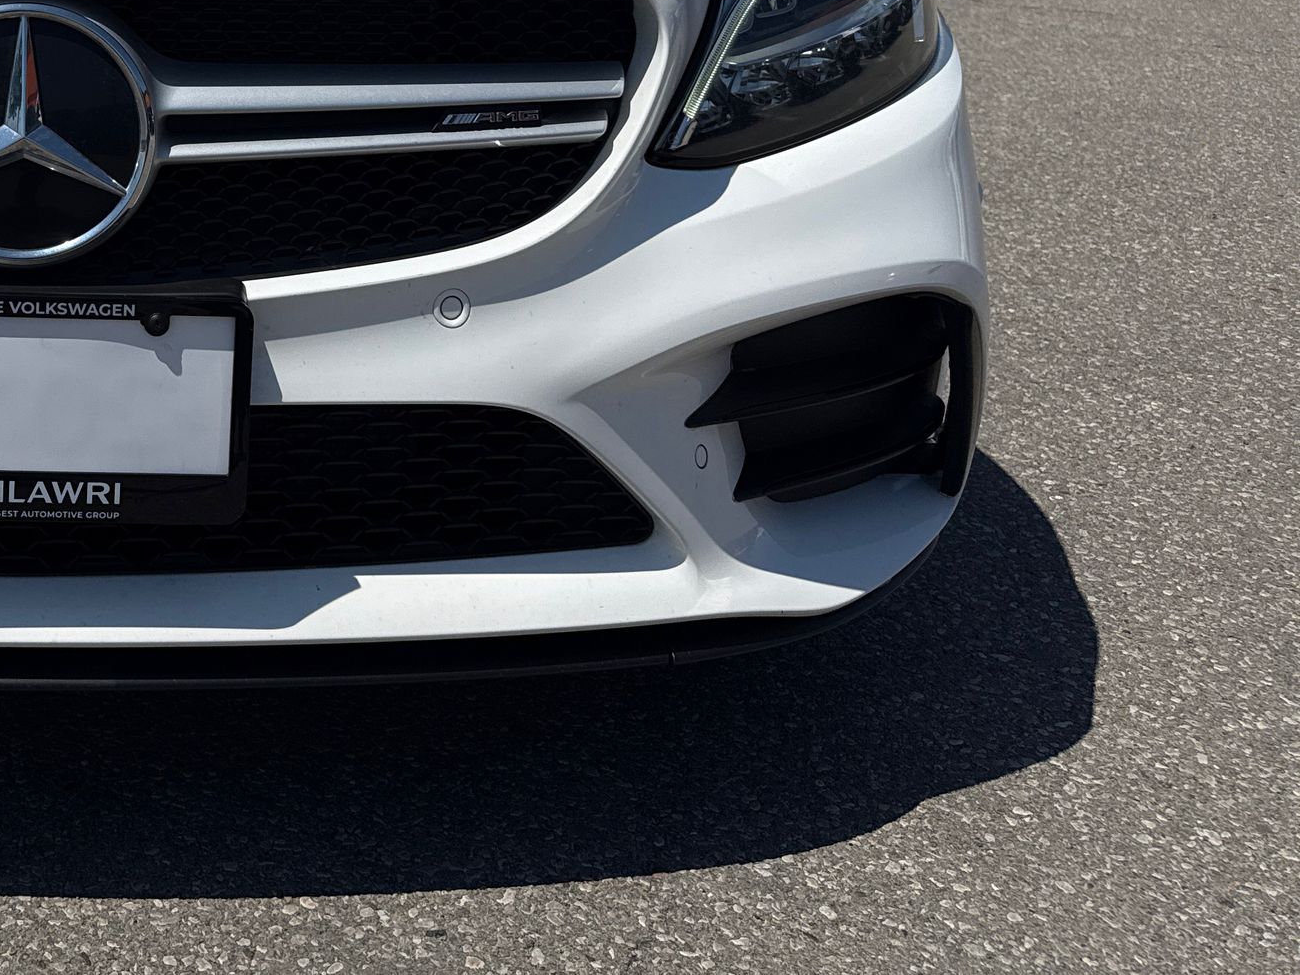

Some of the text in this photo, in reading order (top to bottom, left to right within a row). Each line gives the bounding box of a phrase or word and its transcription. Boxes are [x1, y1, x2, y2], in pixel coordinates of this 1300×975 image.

[474, 110, 539, 123] AMG
[8, 301, 136, 317] VOLKSWAGEN
[20, 510, 83, 519] AUTOMOTIVE
[85, 511, 120, 520] GROUP
